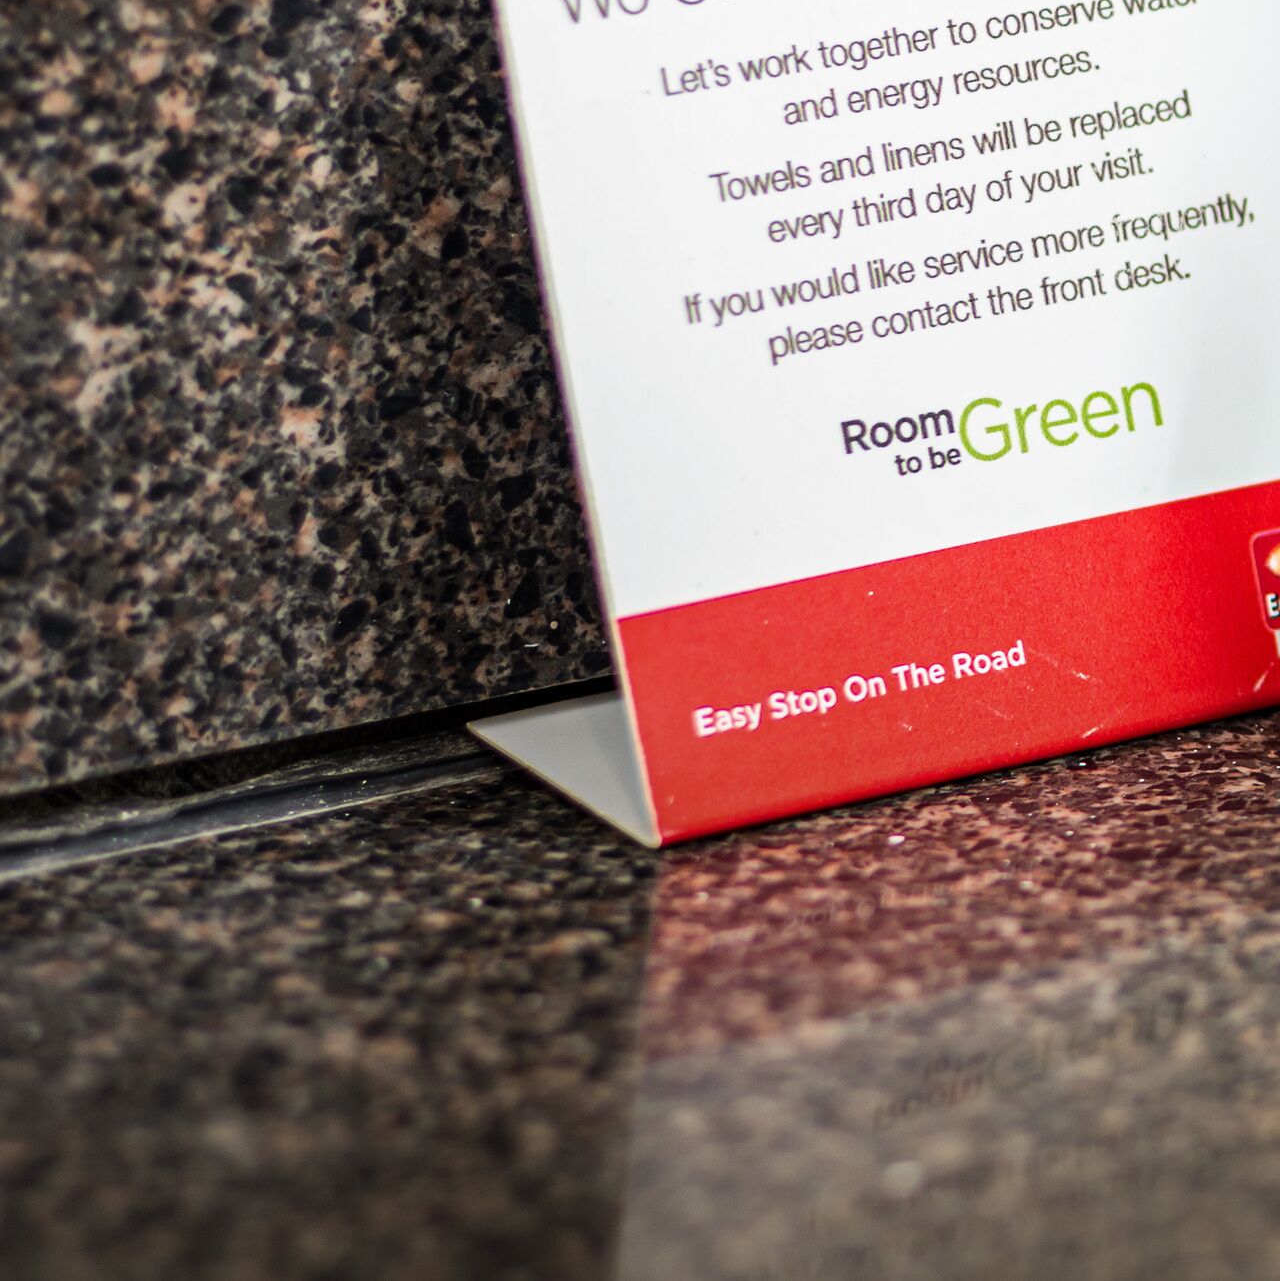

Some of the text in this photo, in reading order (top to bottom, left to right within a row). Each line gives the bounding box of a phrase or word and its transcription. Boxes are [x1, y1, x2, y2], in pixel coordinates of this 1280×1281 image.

[660, 59, 731, 96] Let's
[737, 44, 813, 82] work
[817, 27, 939, 71] together
[946, 19, 977, 46] to
[783, 51, 1100, 125] and energy resources.
[708, 89, 1192, 202] Towels and linens will be replaced
[768, 148, 1154, 243] every third day of your visit.
[684, 193, 1254, 327] If you would like service more frequently,
[768, 254, 1191, 366] please contact the front desk.
[841, 408, 956, 454] Room
[894, 446, 962, 476] to be
[959, 382, 1164, 462] Green
[692, 640, 1027, 738] Easy Stop On The Road
